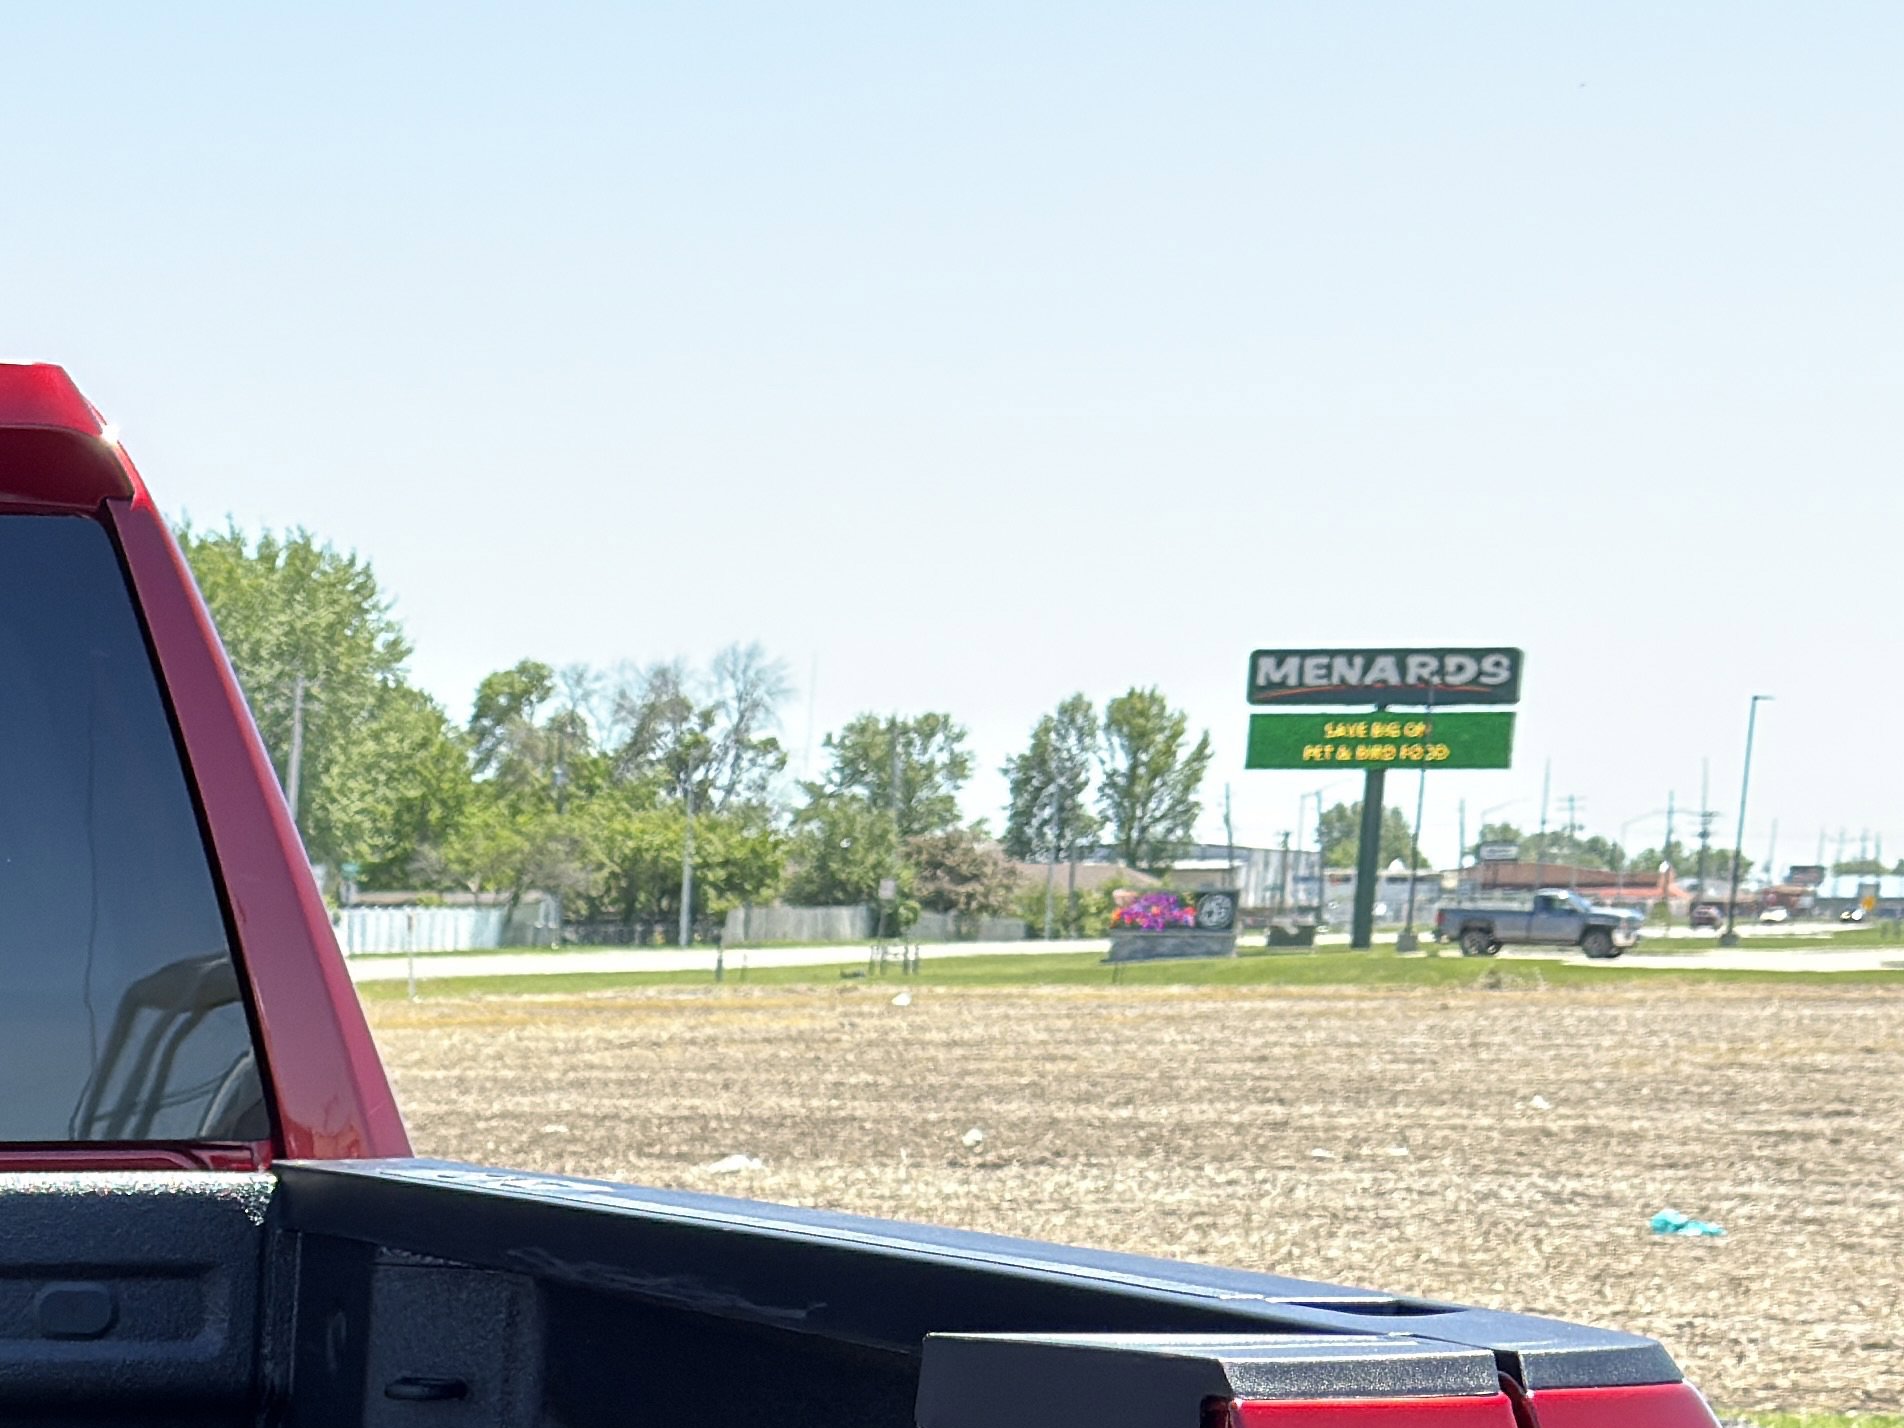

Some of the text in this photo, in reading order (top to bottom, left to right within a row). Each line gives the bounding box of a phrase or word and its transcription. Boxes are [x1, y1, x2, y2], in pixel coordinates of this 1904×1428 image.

[1255, 654, 1511, 686] MENARDS
[1324, 721, 1369, 738] SAVE
[1370, 721, 1401, 738] BIG
[1302, 743, 1334, 761] PET
[1335, 744, 1352, 761] &
[1355, 743, 1397, 761] BIRD
